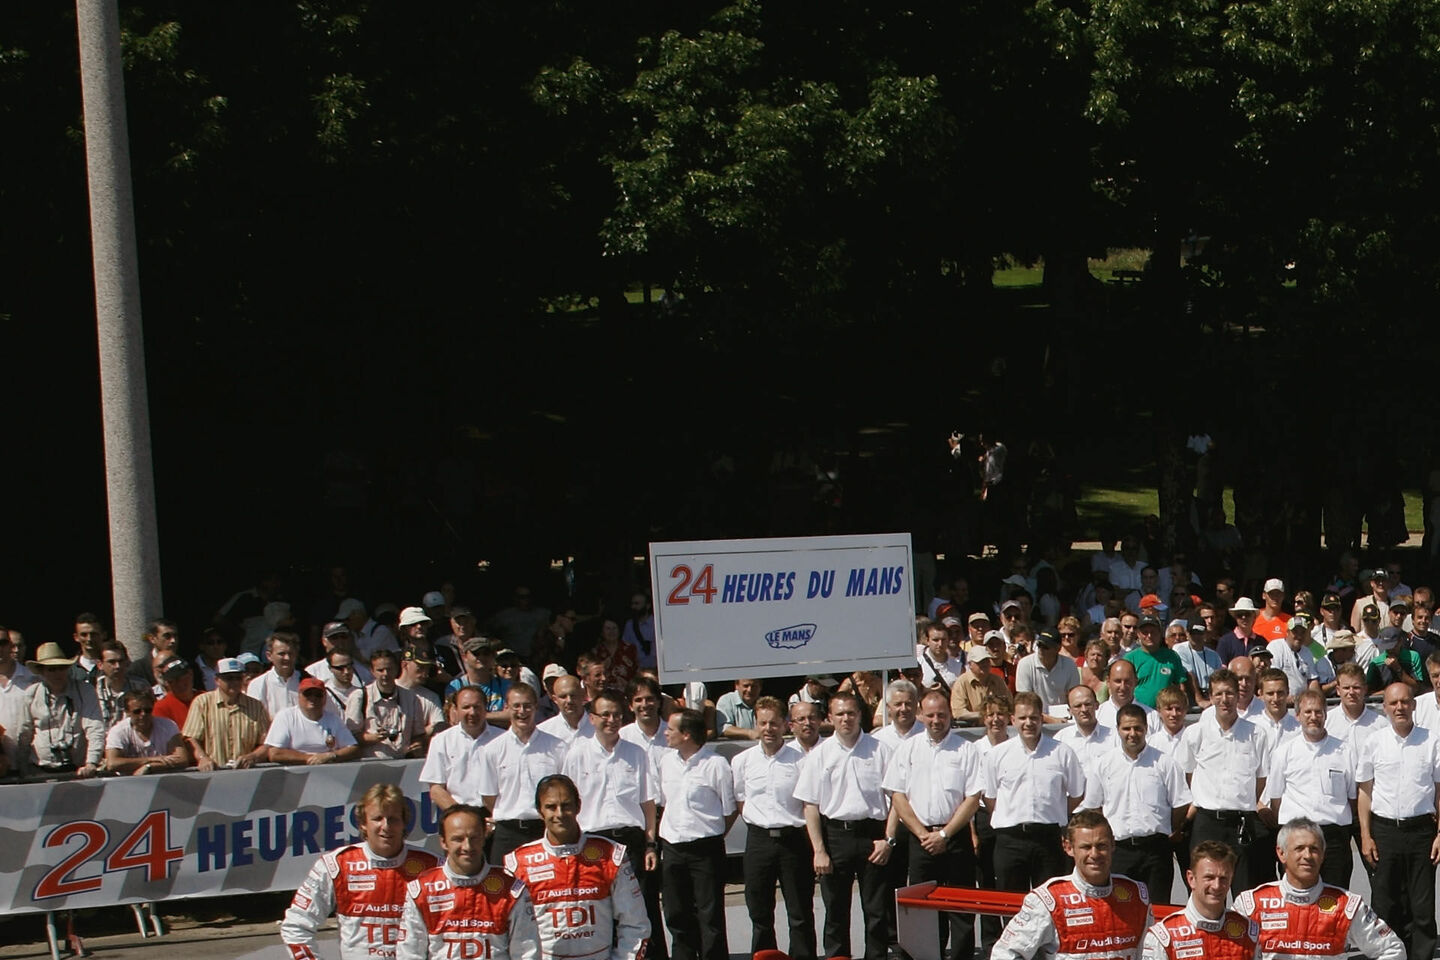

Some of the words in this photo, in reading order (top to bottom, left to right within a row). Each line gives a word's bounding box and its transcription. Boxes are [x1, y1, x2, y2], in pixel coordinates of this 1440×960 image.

[666, 564, 718, 606] 24
[721, 571, 796, 603] HEURES
[807, 570, 836, 599] DU
[845, 566, 904, 597] MANS
[769, 630, 780, 642] LE
[782, 629, 811, 642] MANS
[32, 808, 185, 901] 24
[525, 852, 550, 864] TDI
[347, 861, 371, 871] TDI
[424, 881, 450, 891] TDI
[548, 887, 571, 897] Audi
[573, 886, 599, 898] Sport
[1060, 894, 1087, 905] TDI
[1259, 898, 1285, 909] TDI
[366, 904, 389, 912] Audi
[545, 905, 596, 929] TDI
[360, 923, 399, 944] TD
[554, 930, 595, 941] Power
[1168, 926, 1196, 937] TDI
[1089, 937, 1112, 947] Audi
[1113, 936, 1135, 946] Sport
[1277, 940, 1301, 949] Audi
[1303, 941, 1331, 951] Sport
[369, 948, 396, 958] Pow
[443, 938, 492, 960] TDI
